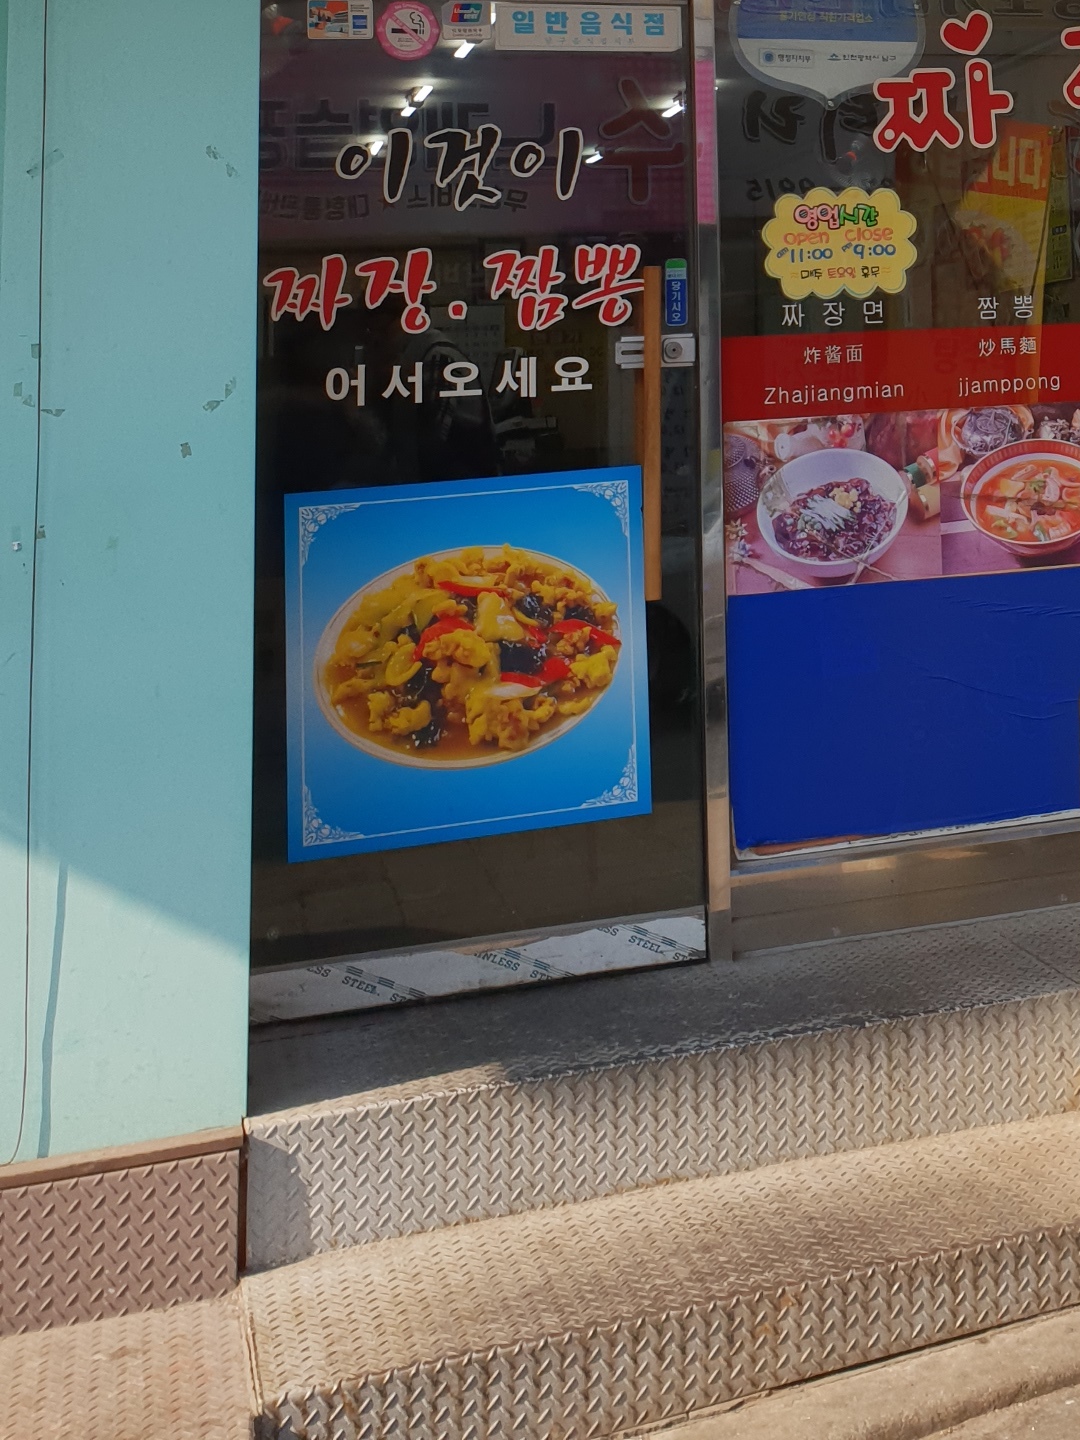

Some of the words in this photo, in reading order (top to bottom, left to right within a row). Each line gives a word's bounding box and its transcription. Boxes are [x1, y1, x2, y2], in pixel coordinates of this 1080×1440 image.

[511, 10, 665, 37] 일반음식점
[335, 124, 584, 212] 이것이
[794, 203, 879, 231] 영업시간
[790, 248, 833, 263] 11:00
[853, 243, 896, 260] 9:00
[800, 268, 823, 280] 매주
[827, 267, 857, 279] 토요일
[861, 266, 880, 279] 휴무
[671, 281, 682, 322] 당기시오
[781, 300, 884, 328] 짜장면
[977, 295, 1035, 321] 짬뽕
[803, 344, 864, 366] 炸酱面
[325, 355, 593, 406] 어서오세요
[764, 381, 905, 407] Zhajiangmian
[958, 374, 1062, 398] jjamppong
